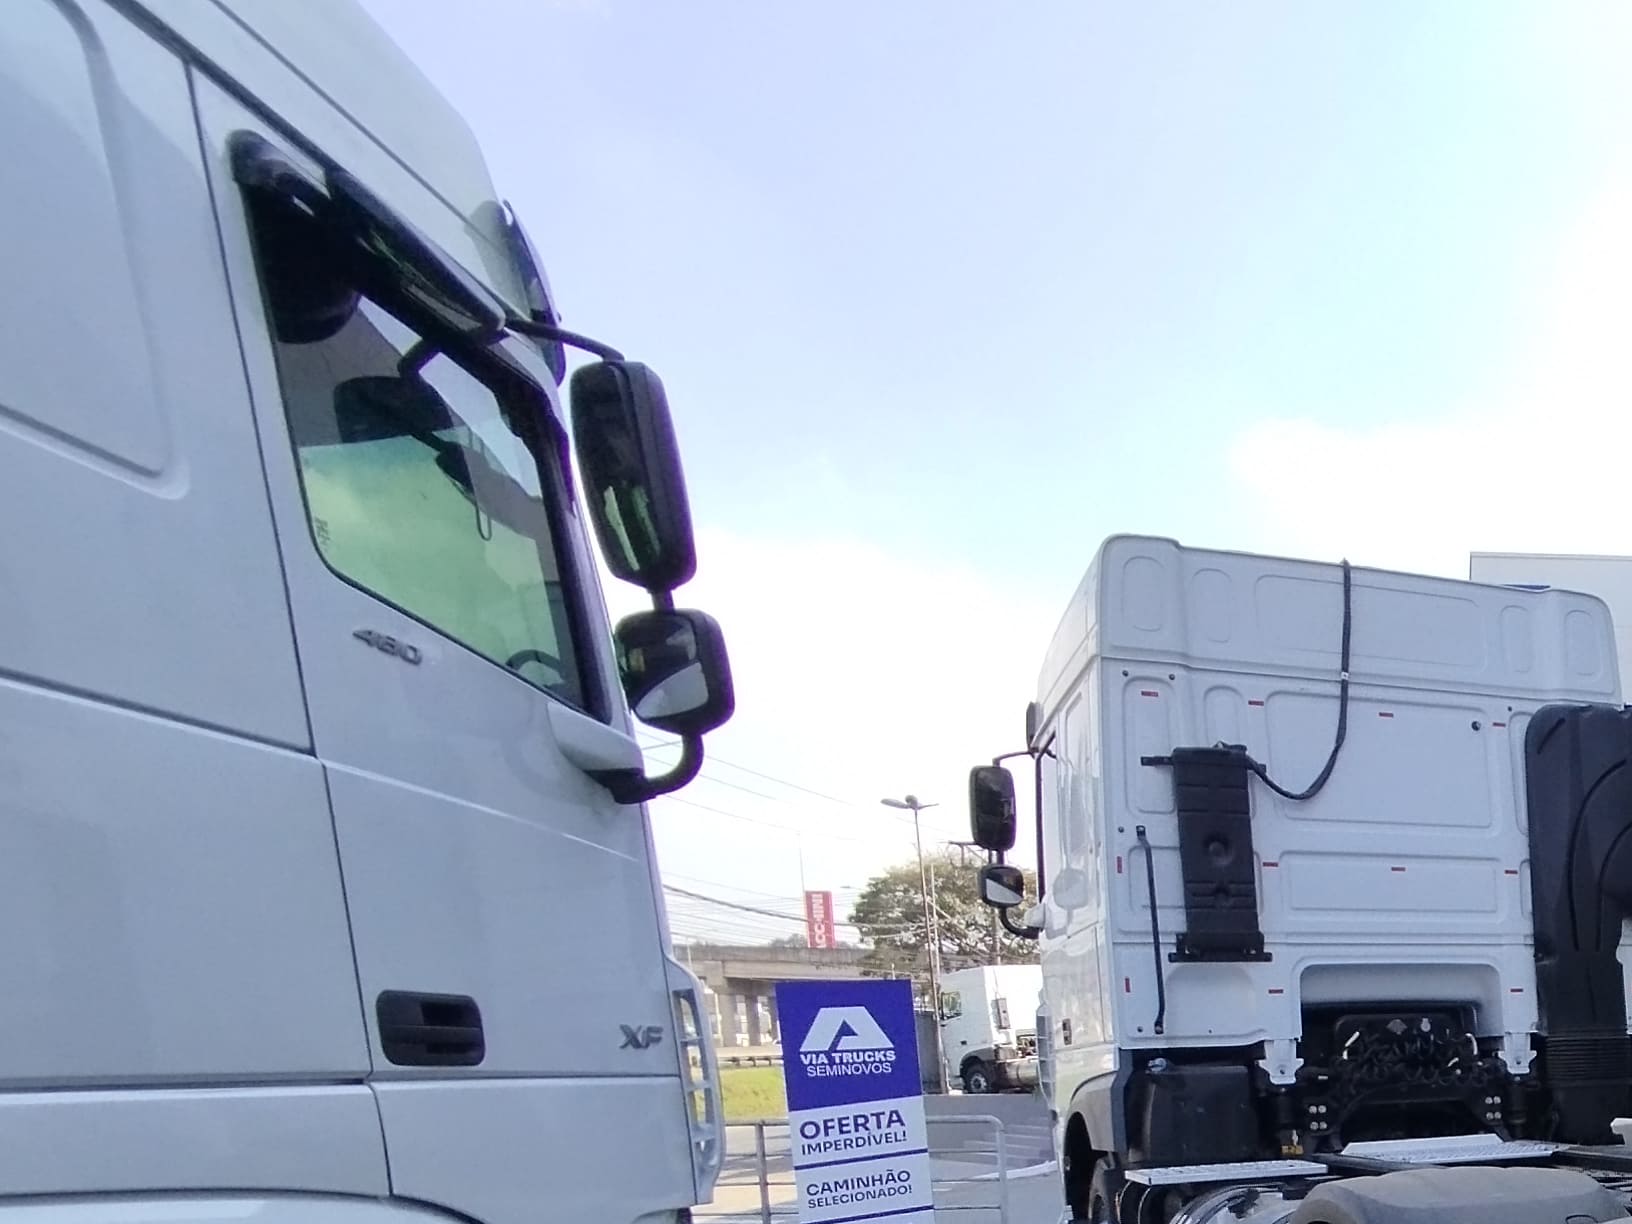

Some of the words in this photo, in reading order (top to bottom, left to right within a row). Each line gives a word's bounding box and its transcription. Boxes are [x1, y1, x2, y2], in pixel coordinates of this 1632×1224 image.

[619, 1023, 664, 1050] XF
[800, 1053, 829, 1065] VIA
[831, 1050, 897, 1064] TRUCKS
[806, 1062, 893, 1077] SEMINOVOS
[799, 1109, 906, 1140] OFERTA
[801, 1130, 908, 1156] IMPERDÍVEL!
[806, 1168, 911, 1197] CAMINHÃO
[807, 1184, 913, 1209] SELECIONADO!
